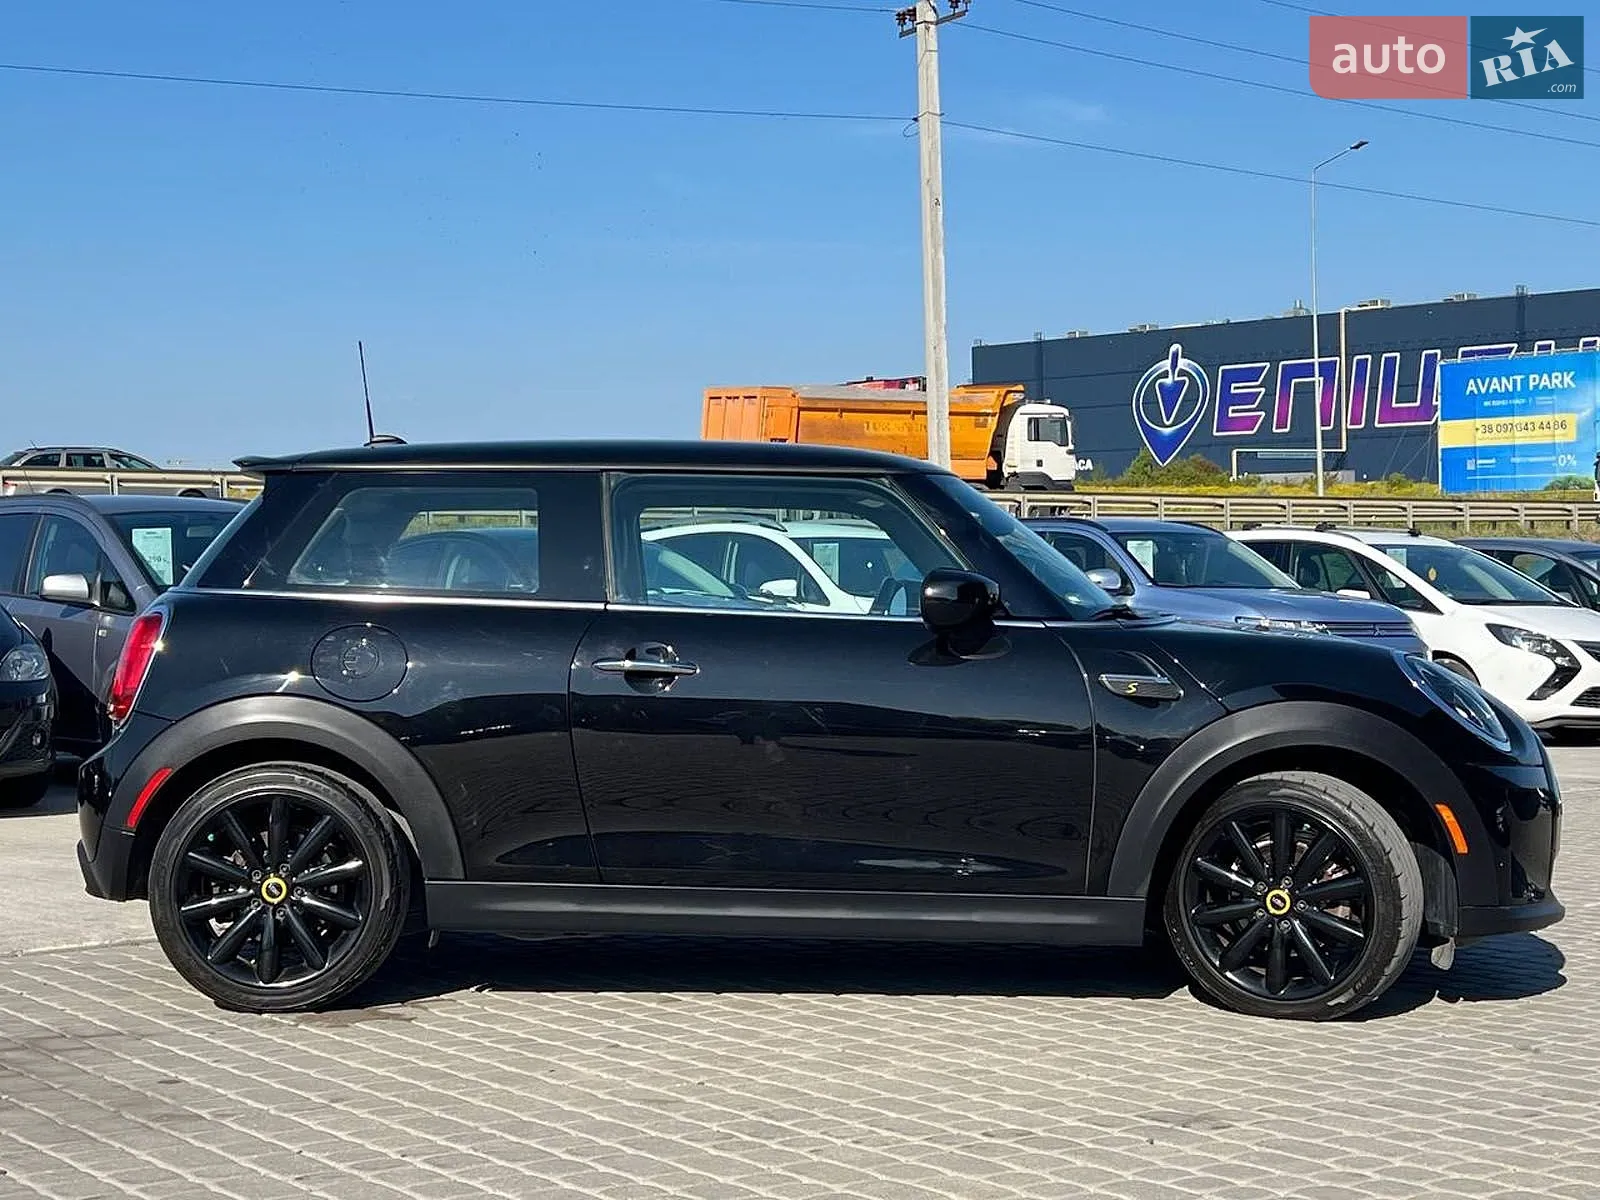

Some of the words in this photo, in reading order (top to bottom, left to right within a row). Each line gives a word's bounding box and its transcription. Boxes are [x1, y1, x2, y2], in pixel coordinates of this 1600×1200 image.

[1465, 374, 1525, 395] AVANT
[1529, 371, 1577, 391] PARK
[1125, 682, 1139, 694] S
